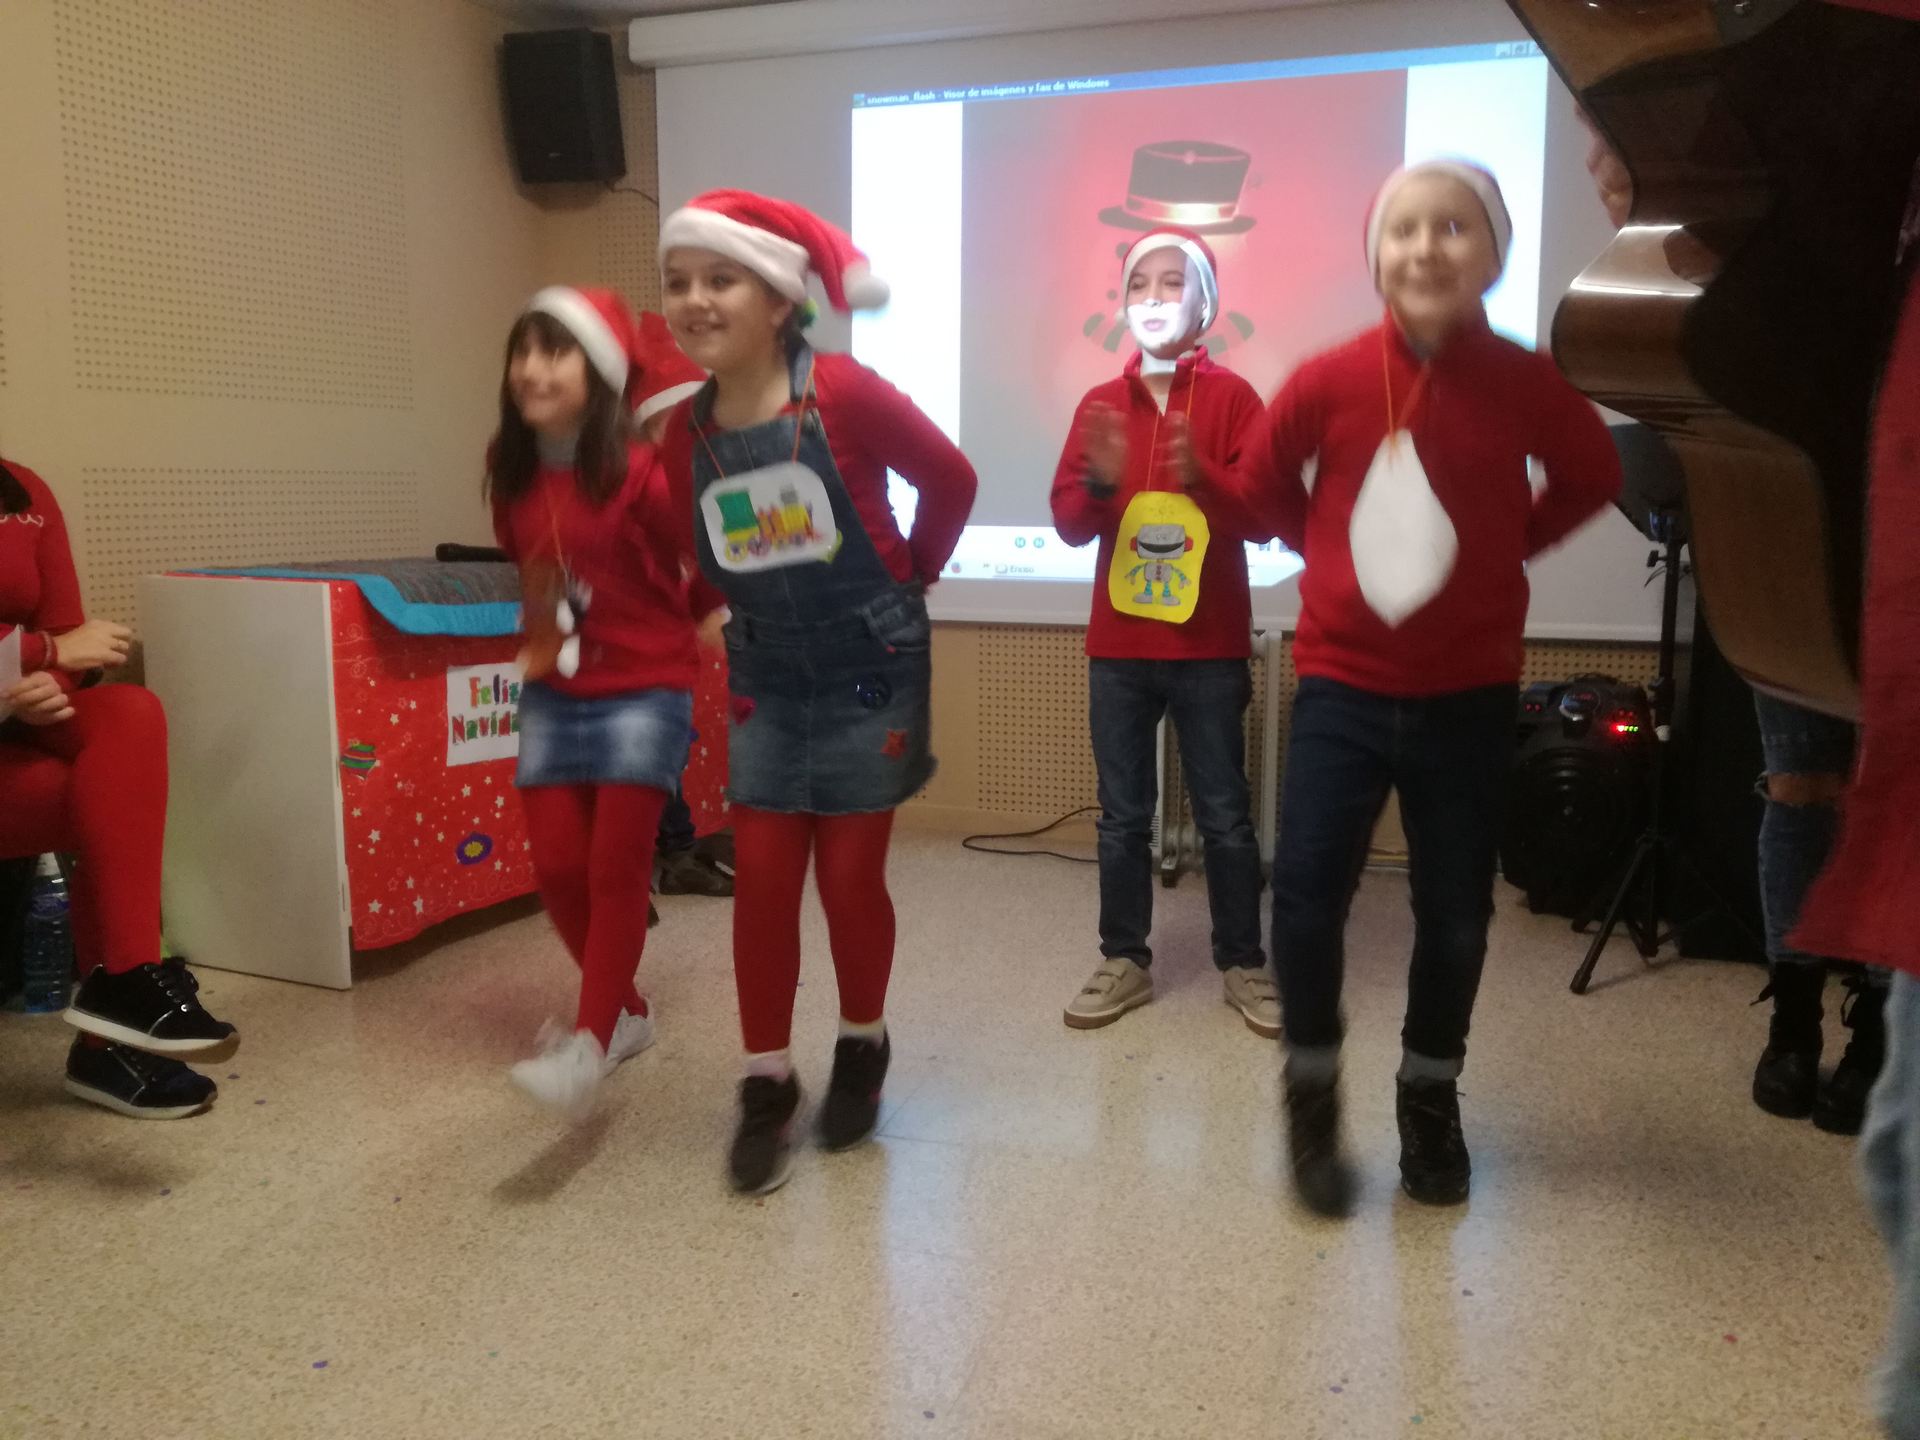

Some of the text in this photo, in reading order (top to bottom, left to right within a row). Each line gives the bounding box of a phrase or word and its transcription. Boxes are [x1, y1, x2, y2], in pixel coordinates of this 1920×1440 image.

[943, 89, 966, 100] Visor
[967, 87, 980, 97] de
[1028, 85, 1035, 95] y
[1053, 80, 1065, 91] de
[1067, 78, 1110, 89] Windows
[452, 711, 520, 744] Navida
